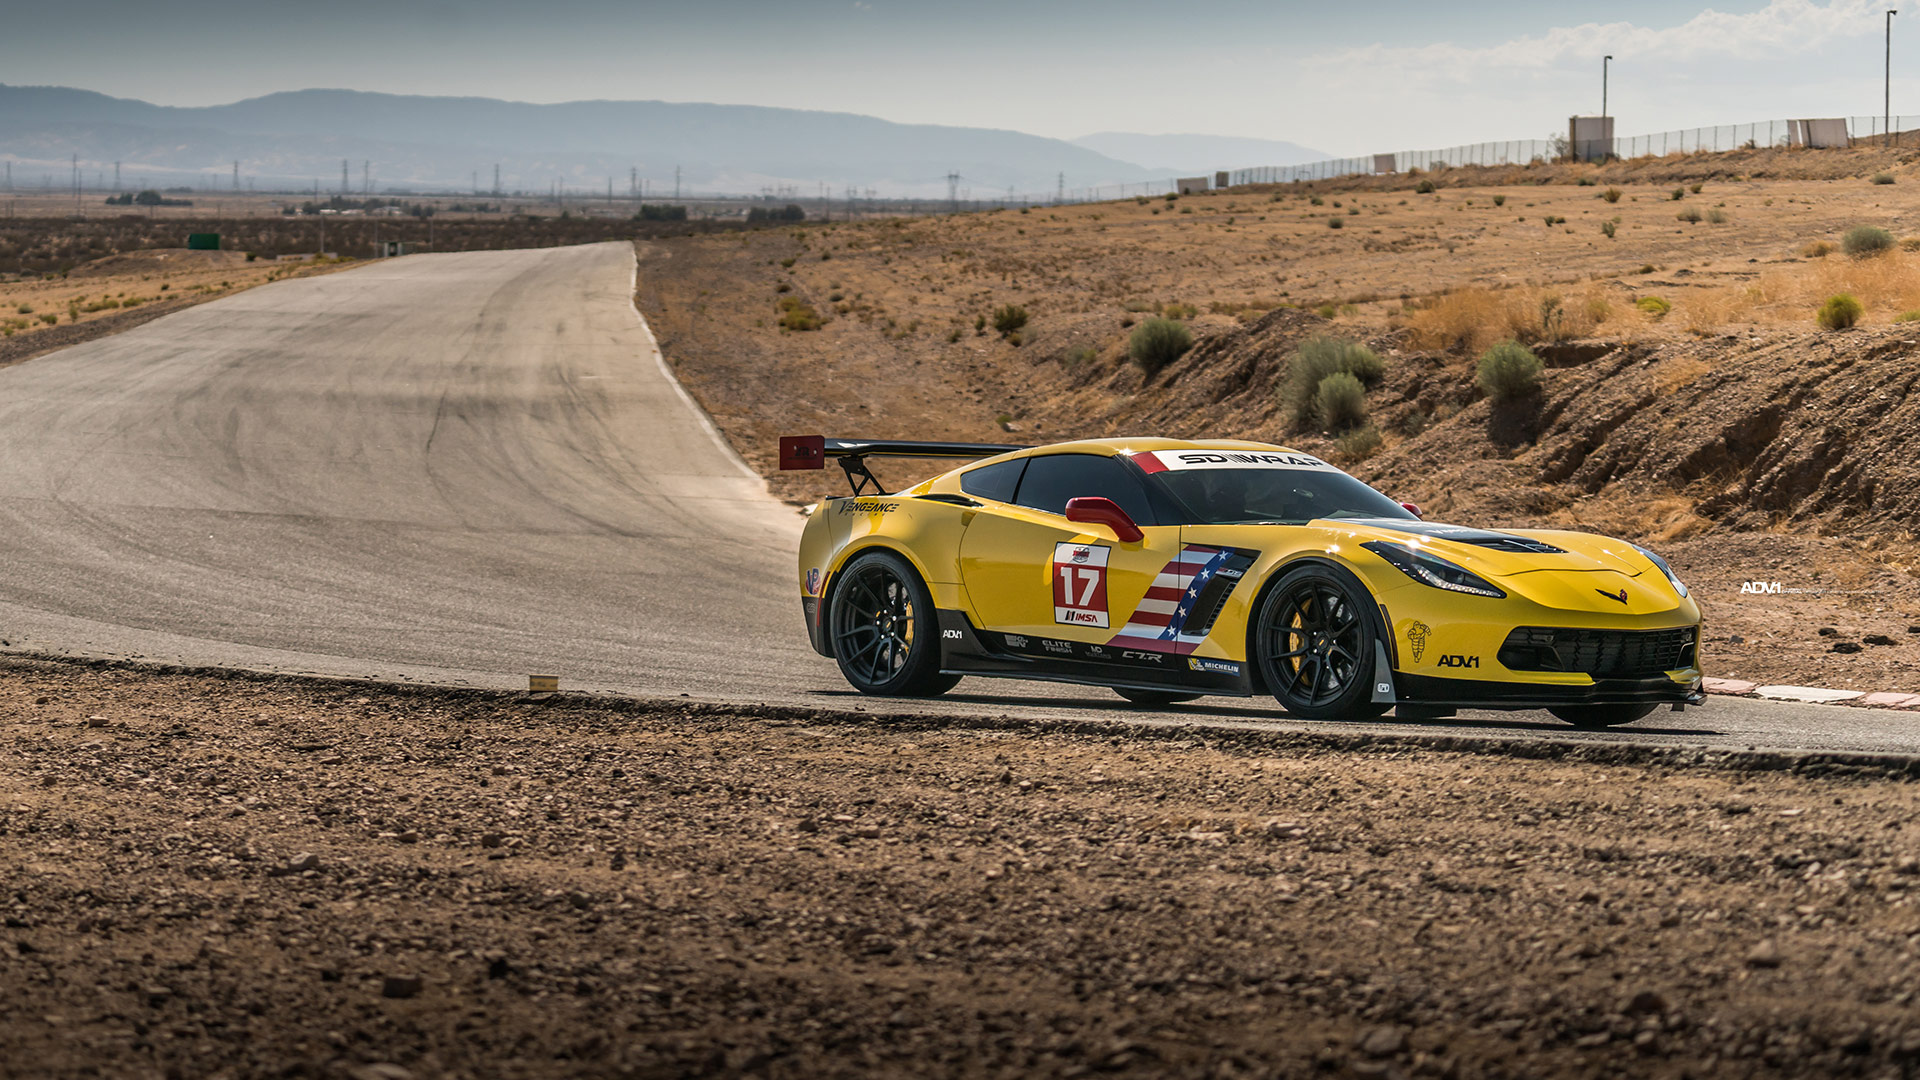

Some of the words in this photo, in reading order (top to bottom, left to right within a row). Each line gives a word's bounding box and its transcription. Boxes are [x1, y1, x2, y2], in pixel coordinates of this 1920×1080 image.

[839, 501, 900, 515] VENGEANCE
[1060, 566, 1100, 607] 17
[1075, 613, 1098, 623] IMSA
[1042, 640, 1072, 649] ELITE
[1204, 662, 1239, 673] MICHELIN
